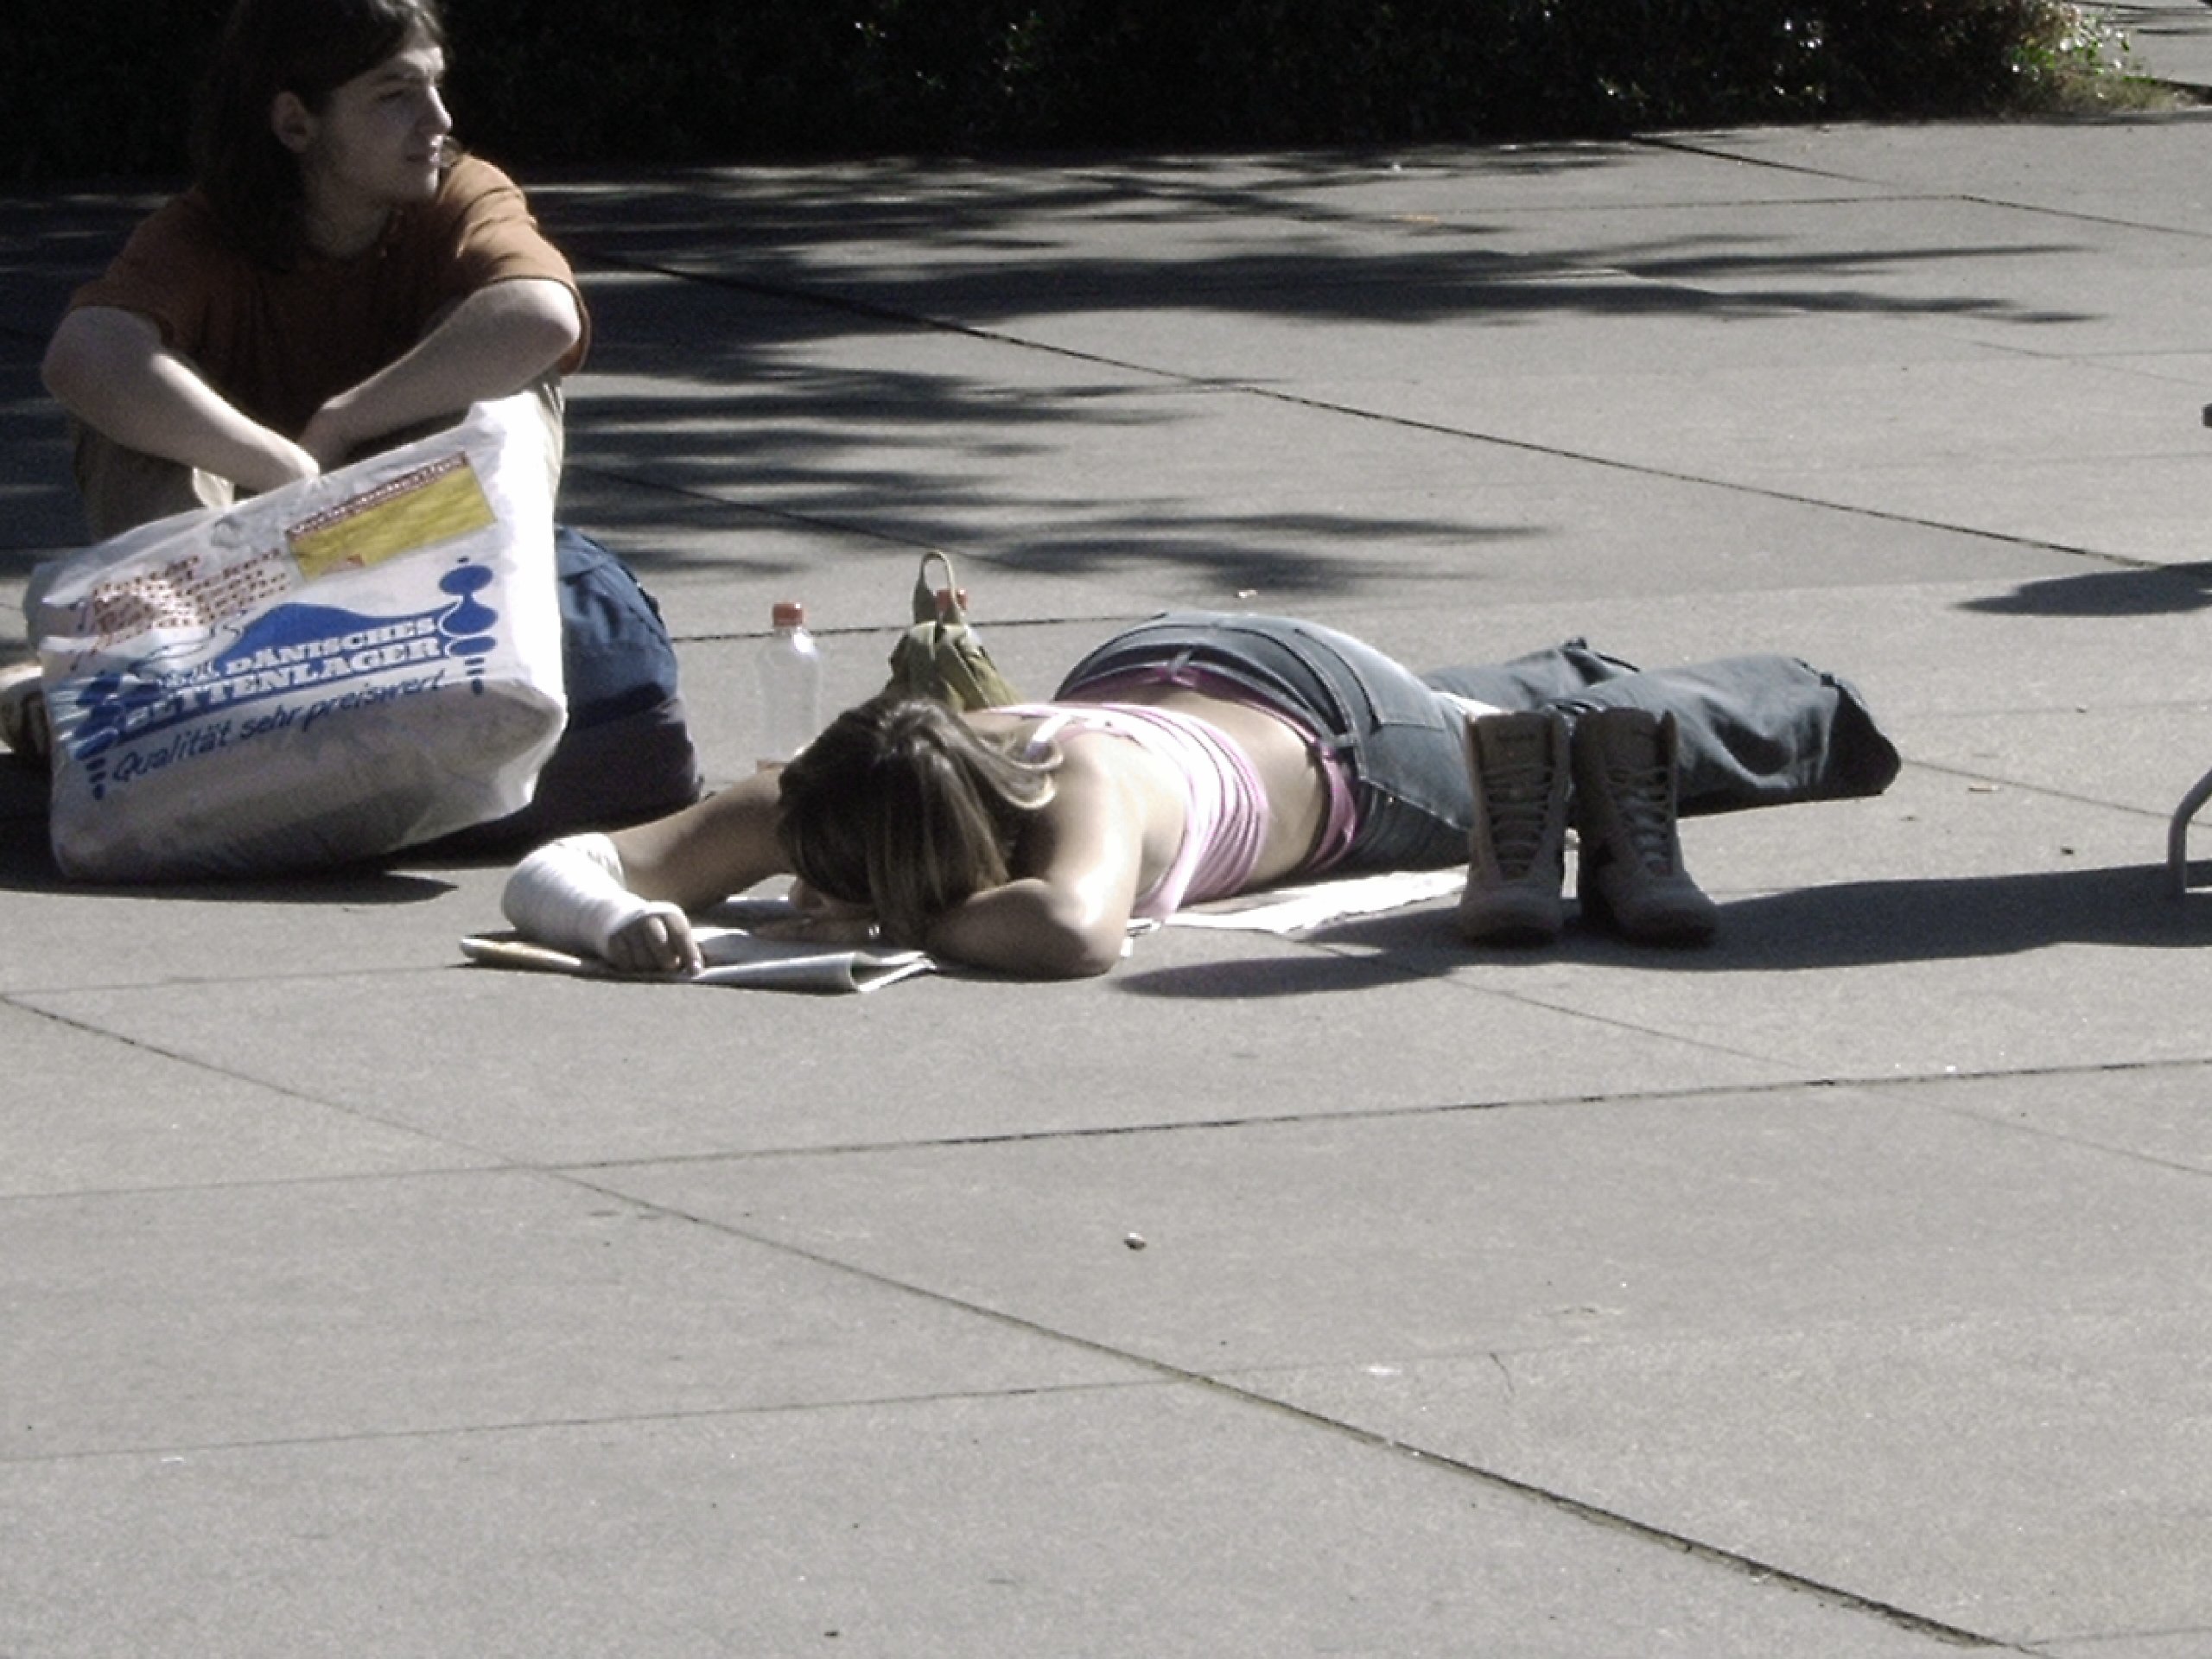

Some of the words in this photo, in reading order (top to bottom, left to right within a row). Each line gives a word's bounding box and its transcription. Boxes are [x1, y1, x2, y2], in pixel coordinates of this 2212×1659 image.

[226, 617, 435, 677] DÄNISCHES
[113, 725, 232, 782] Qualität
[240, 703, 300, 741] sehr
[301, 671, 444, 731] preiswert
